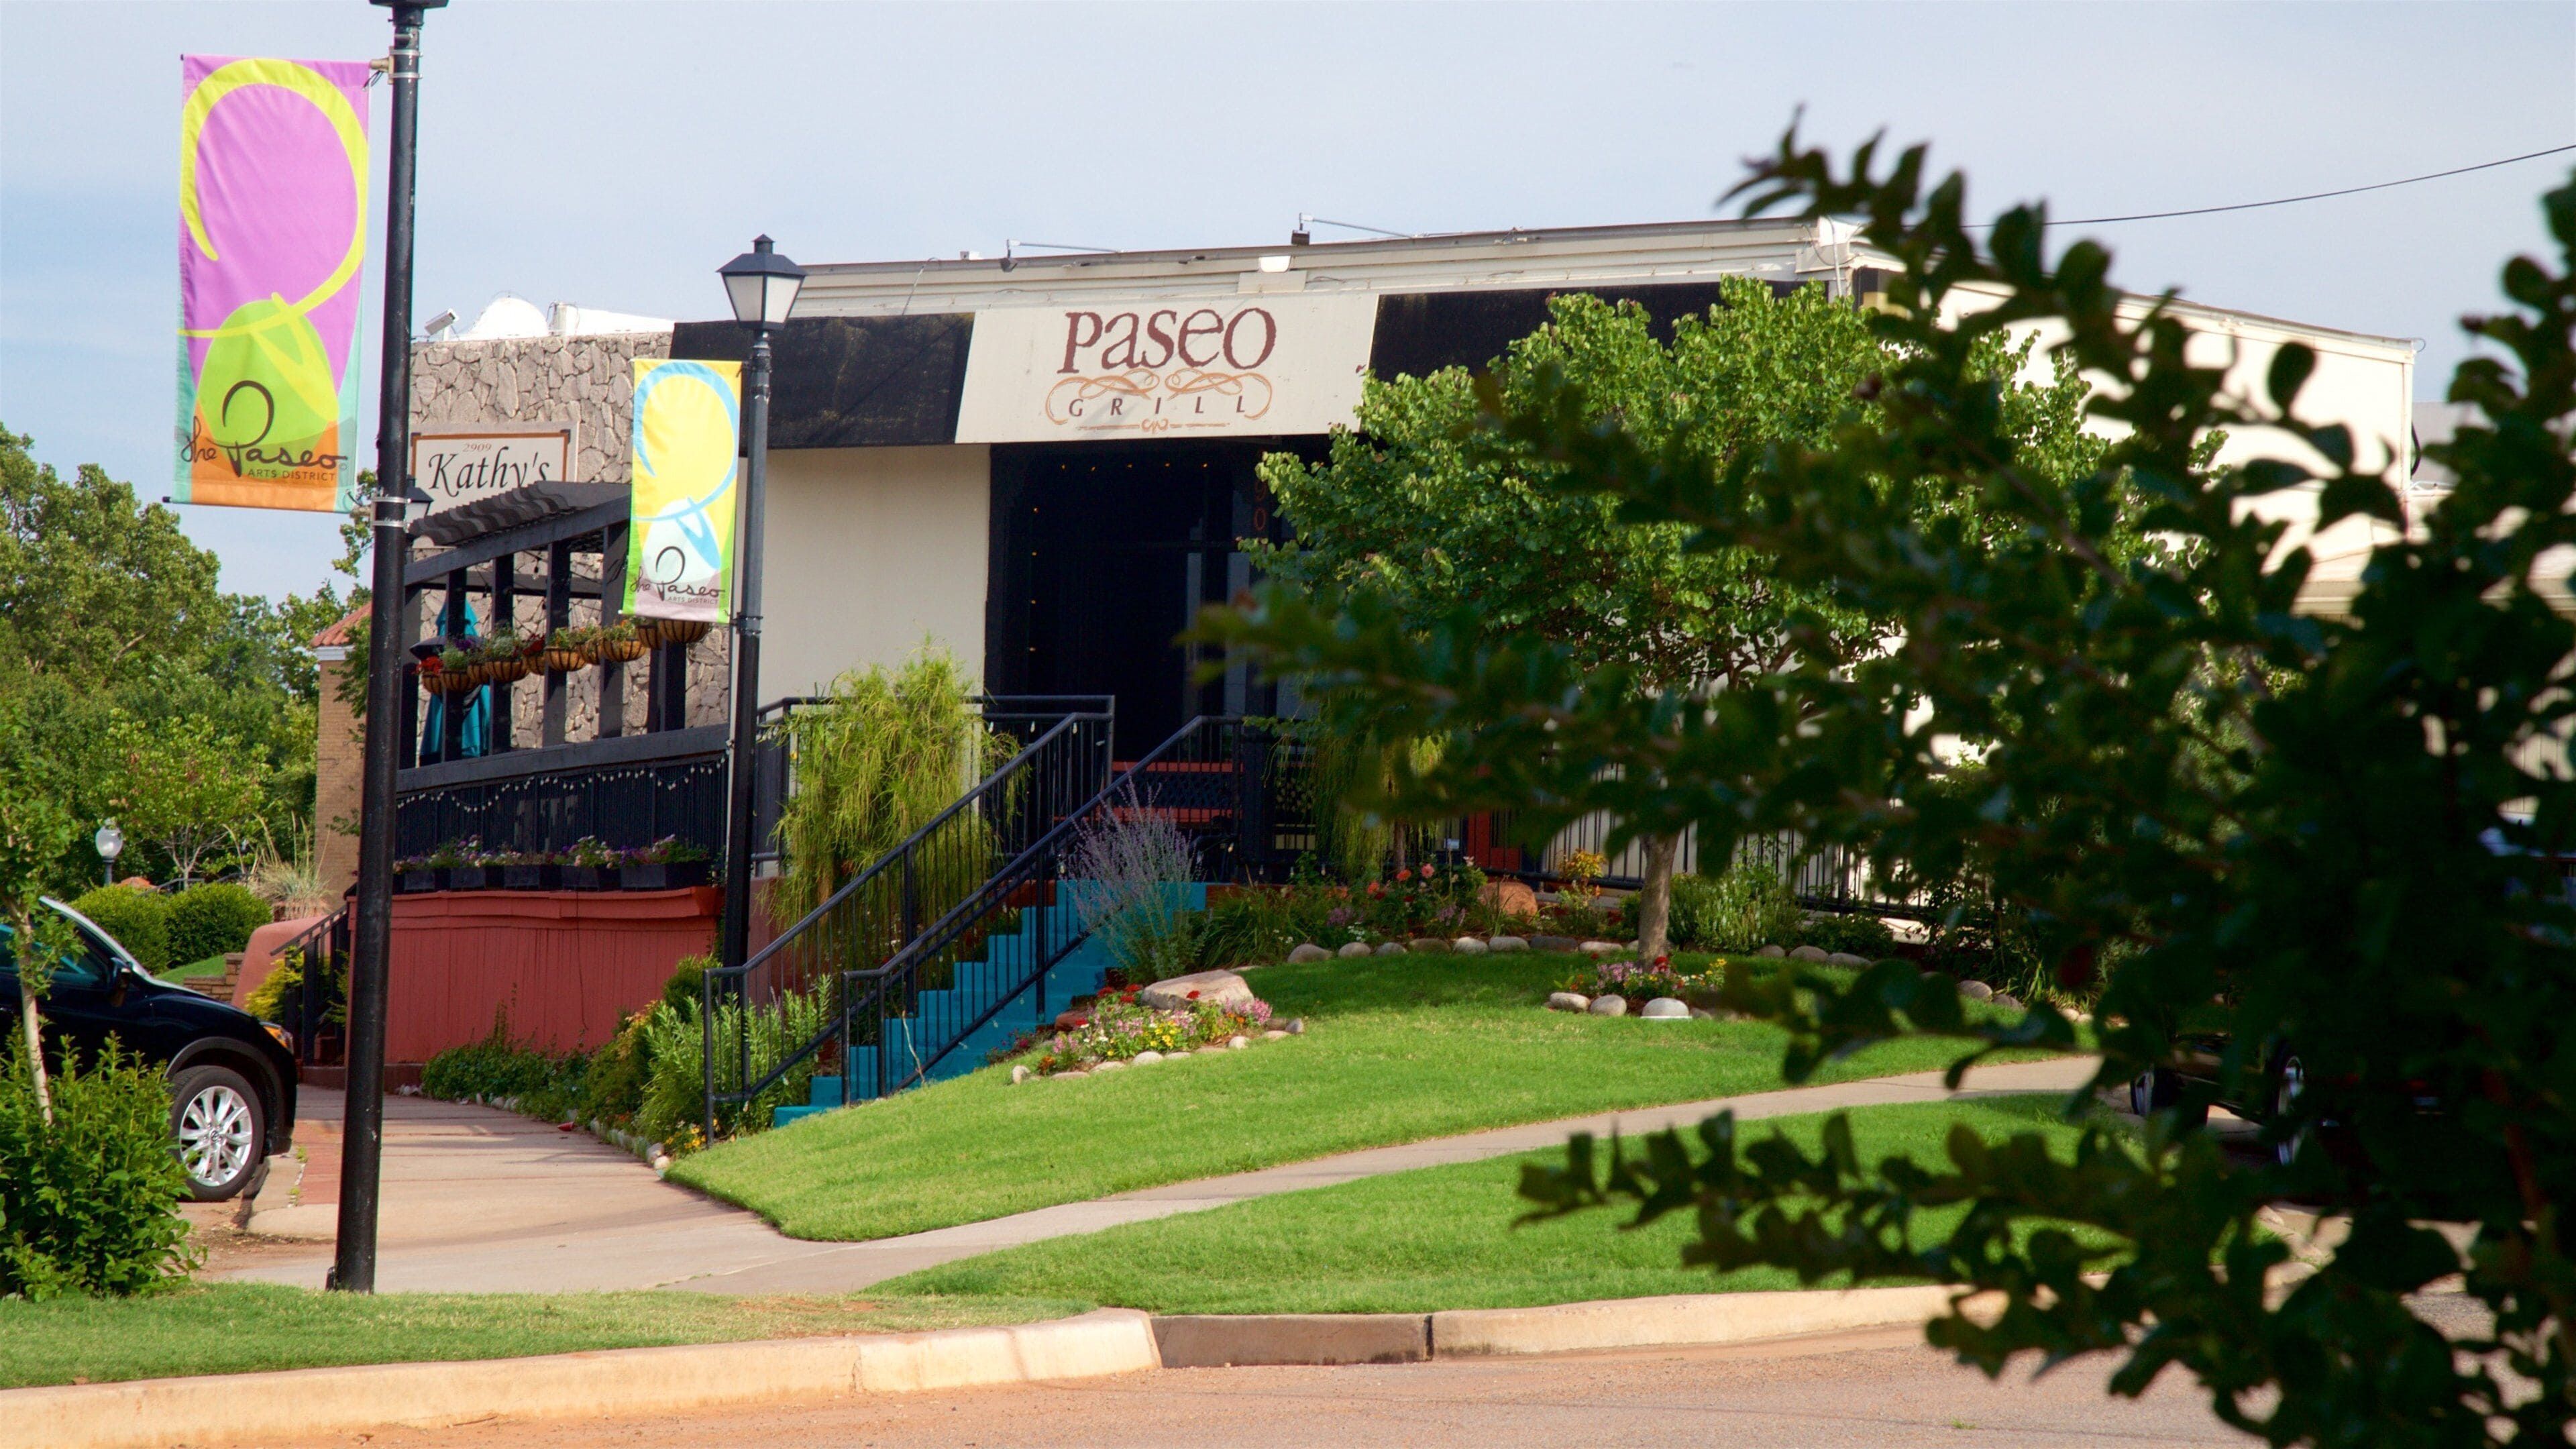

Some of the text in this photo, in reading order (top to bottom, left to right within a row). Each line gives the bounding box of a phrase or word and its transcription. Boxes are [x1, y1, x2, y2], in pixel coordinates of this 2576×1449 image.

[1068, 395, 1246, 417] GRILL
[206, 380, 348, 478] Paseo
[462, 443, 492, 453] 2909
[248, 469, 335, 481] ARTS DISTRICT
[428, 445, 550, 498] Kathy's
[645, 545, 725, 601] Paseo
[688, 597, 718, 605] DISTRICT
